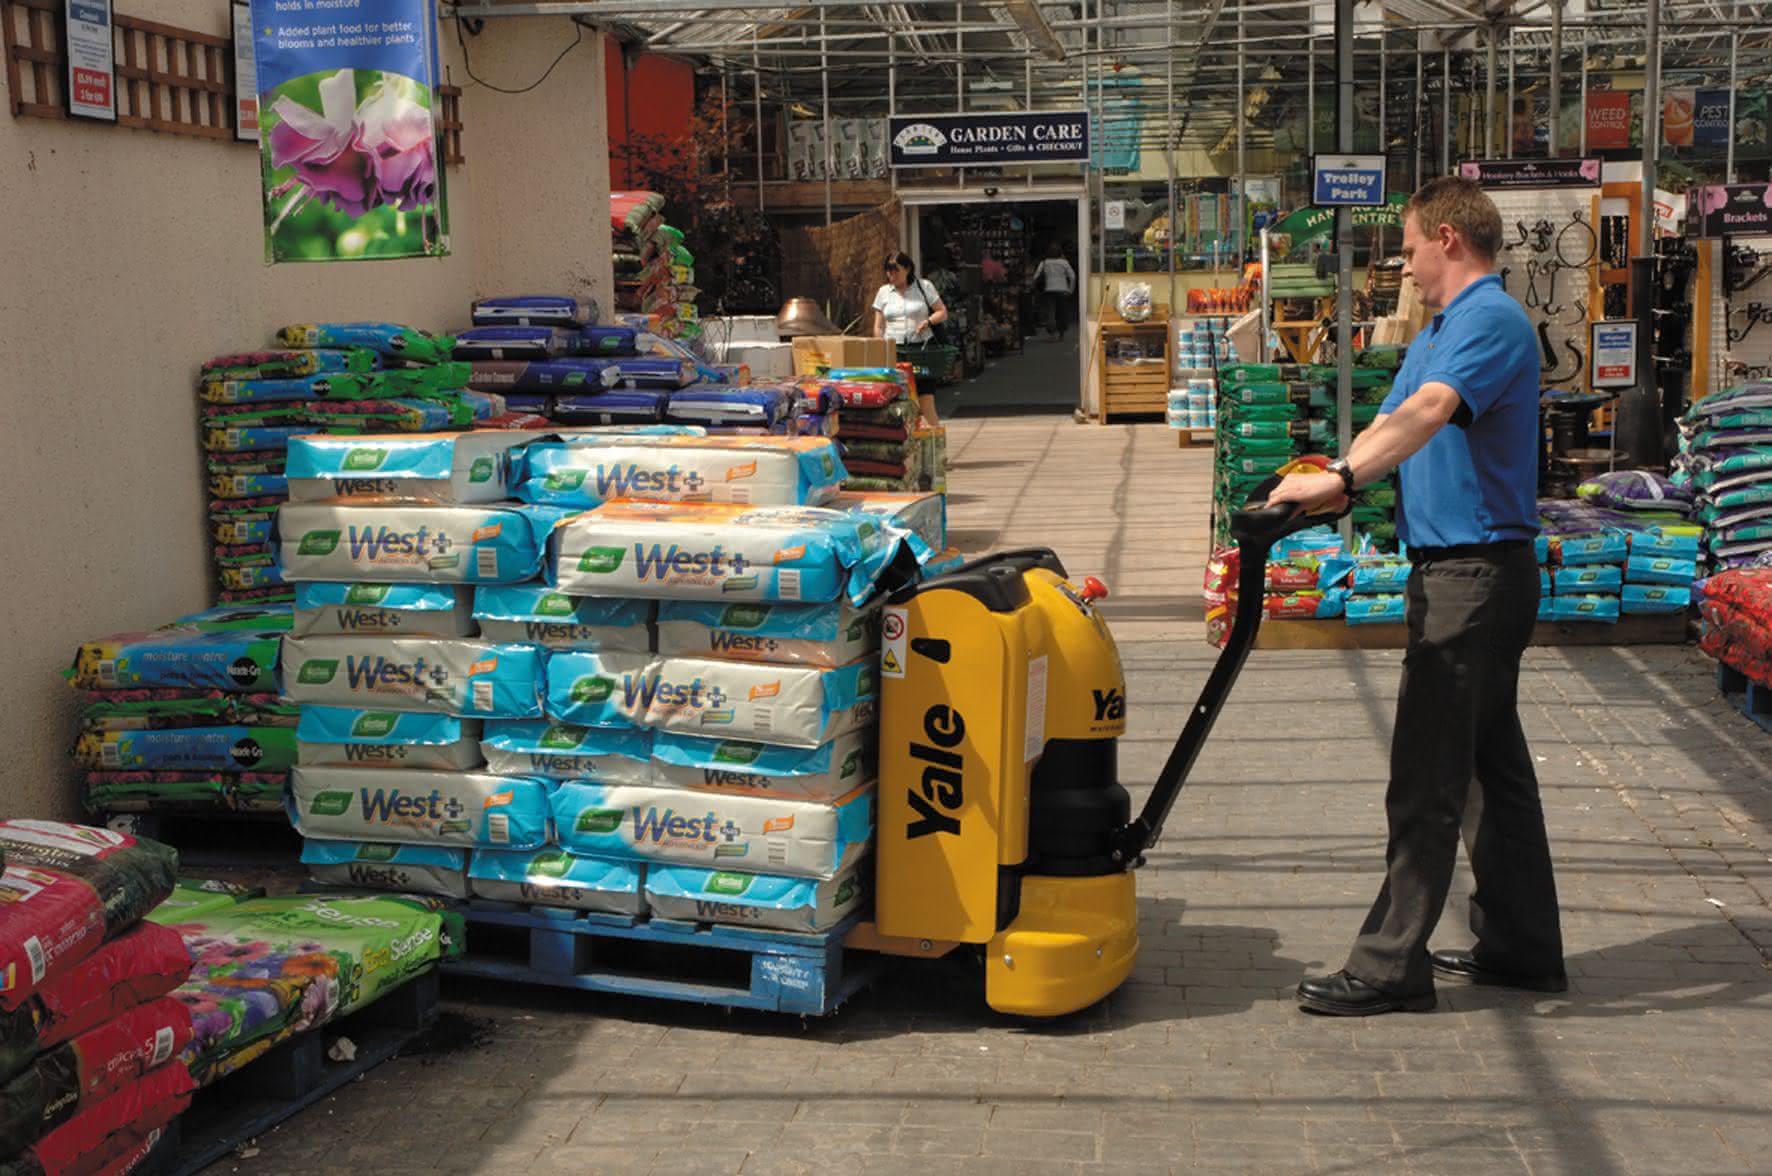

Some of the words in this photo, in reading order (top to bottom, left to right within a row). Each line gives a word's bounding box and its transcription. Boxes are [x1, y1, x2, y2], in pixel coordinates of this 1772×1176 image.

[275, 0, 302, 11] holds
[304, 0, 314, 10] in
[316, 0, 360, 9] moisture
[278, 26, 310, 37] Added
[311, 25, 337, 37] plant
[339, 24, 362, 33] food
[364, 23, 380, 33] for
[382, 22, 412, 32] better
[278, 38, 315, 49] blooms
[317, 37, 336, 47] and
[337, 35, 382, 47] healthier
[385, 34, 415, 45] plants
[1588, 107, 1626, 120] WEED
[1700, 104, 1728, 119] PEST
[1590, 119, 1625, 129] CONTROL
[951, 125, 1026, 143] GARDEN
[1033, 123, 1082, 140] CARE
[951, 145, 973, 154] House
[975, 144, 999, 153] Plants
[1007, 143, 1026, 153] Gifts
[1028, 143, 1034, 151] &
[1036, 142, 1082, 152] CHECKOUT
[1323, 173, 1376, 186] Trolley
[1331, 188, 1368, 200] Park
[1351, 212, 1397, 225] ENTRE
[1723, 212, 1768, 224] Brackets
[596, 463, 705, 496] West+
[349, 525, 452, 562] West+
[634, 543, 750, 581] West+
[346, 655, 448, 691] West+
[623, 673, 727, 709] West+
[906, 703, 966, 840] Yale
[360, 787, 463, 822] West+
[631, 806, 741, 843] West+
[391, 926, 433, 961] Sense
